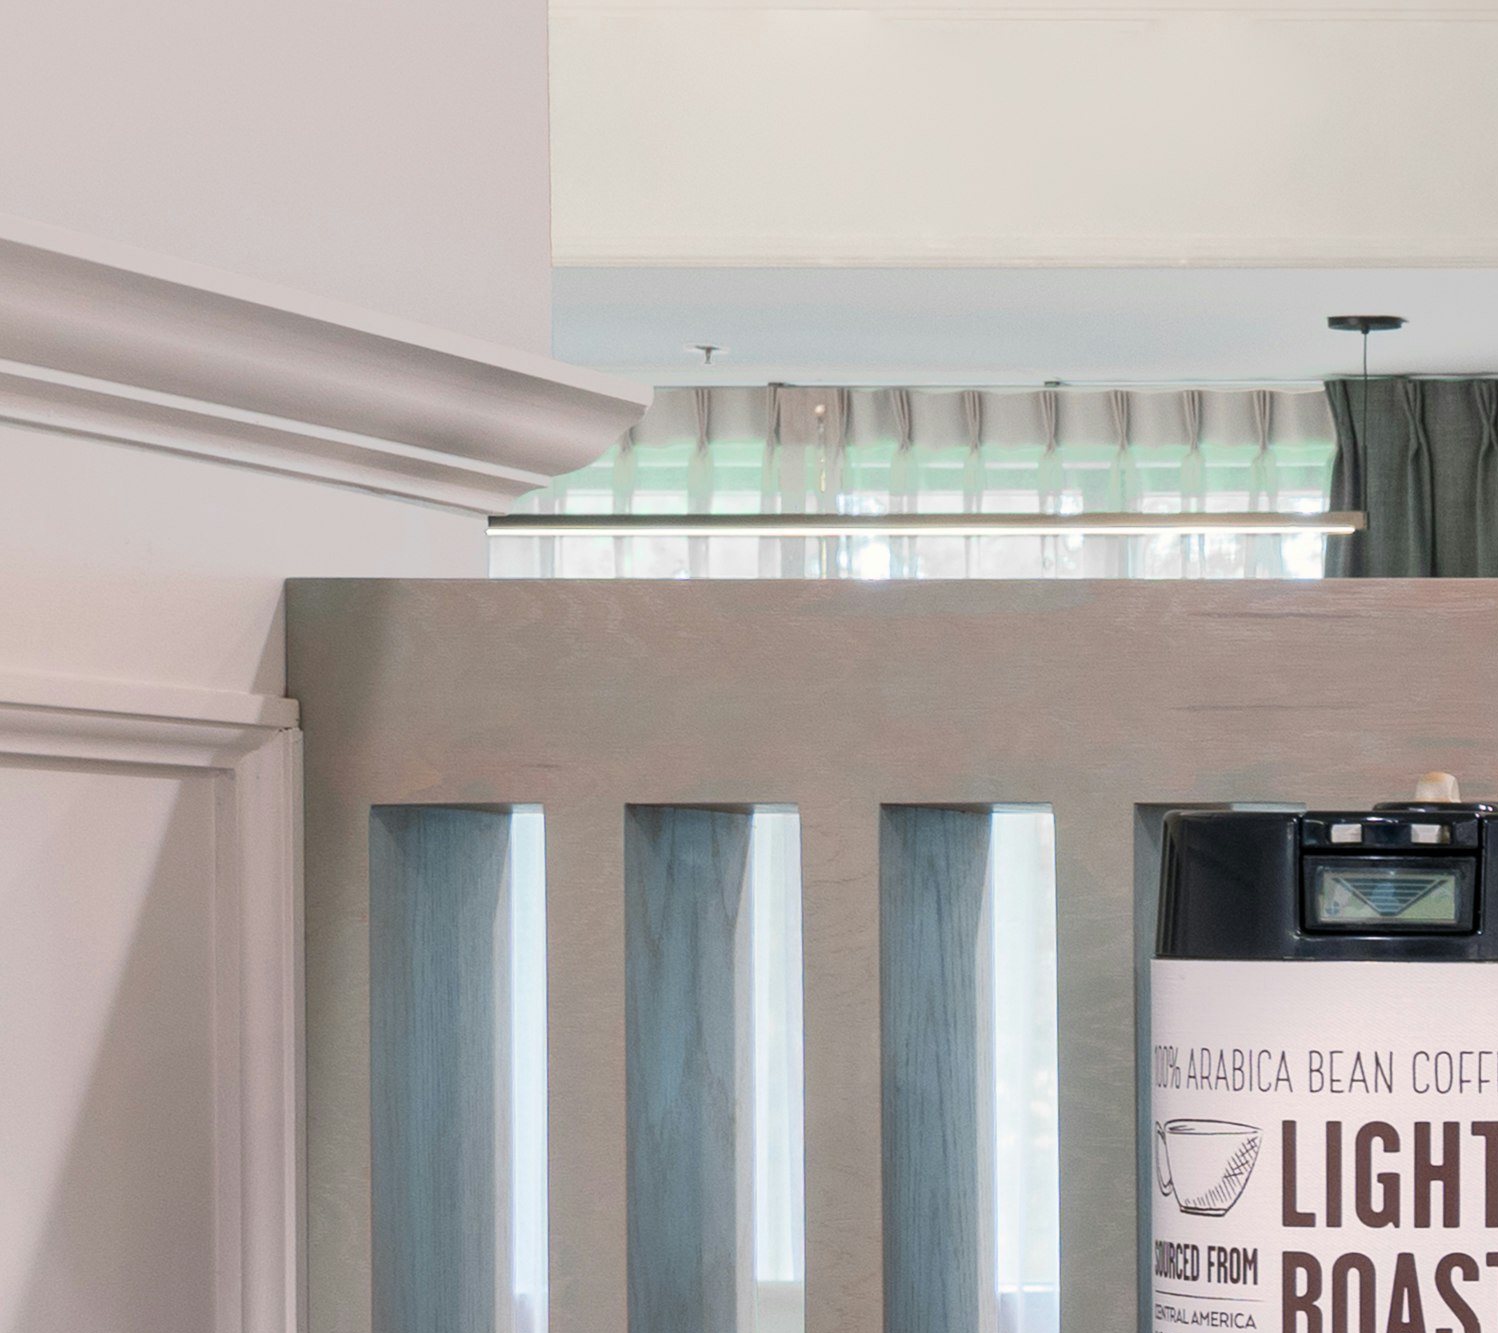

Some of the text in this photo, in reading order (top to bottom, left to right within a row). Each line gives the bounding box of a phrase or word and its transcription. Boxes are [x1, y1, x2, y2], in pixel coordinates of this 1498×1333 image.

[1186, 1047, 1294, 1093] ARABICA
[1309, 1051, 1394, 1094] BEAN
[1207, 1245, 1259, 1286] FROM
[1191, 1311, 1257, 1330] AMERICA
